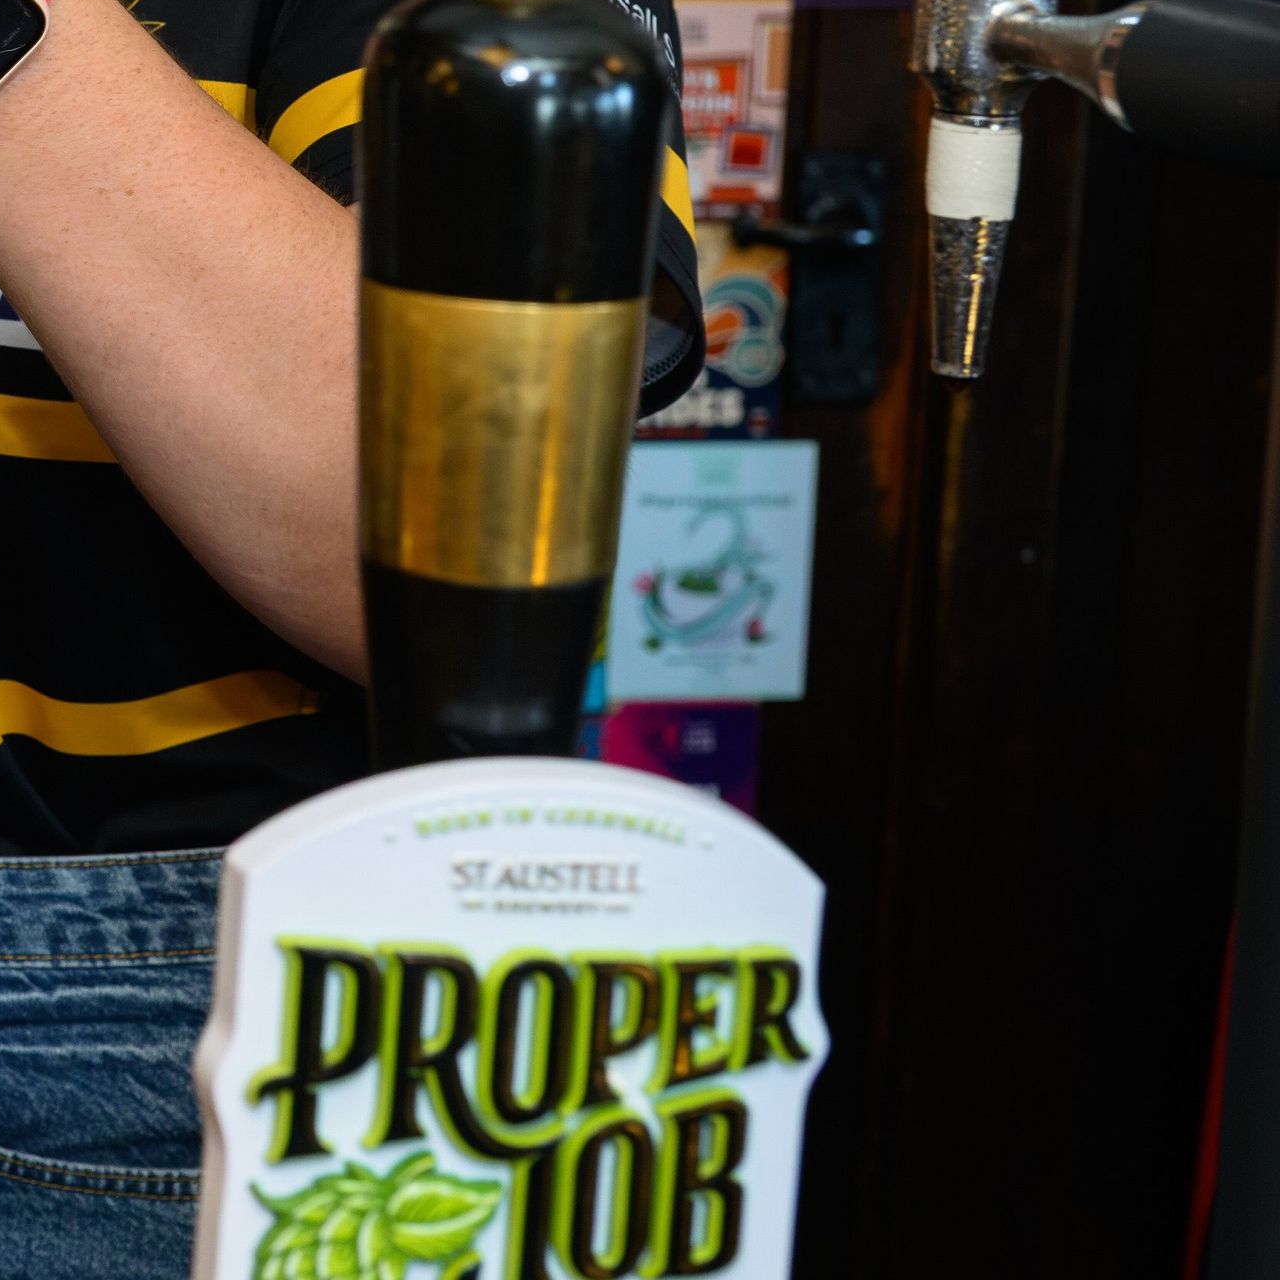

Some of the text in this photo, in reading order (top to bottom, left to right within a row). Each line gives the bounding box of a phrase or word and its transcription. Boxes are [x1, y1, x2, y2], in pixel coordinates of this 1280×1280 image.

[451, 859, 644, 894] ST AUSTELL
[245, 933, 812, 1163] PROPER
[443, 1085, 749, 1280] JOB
